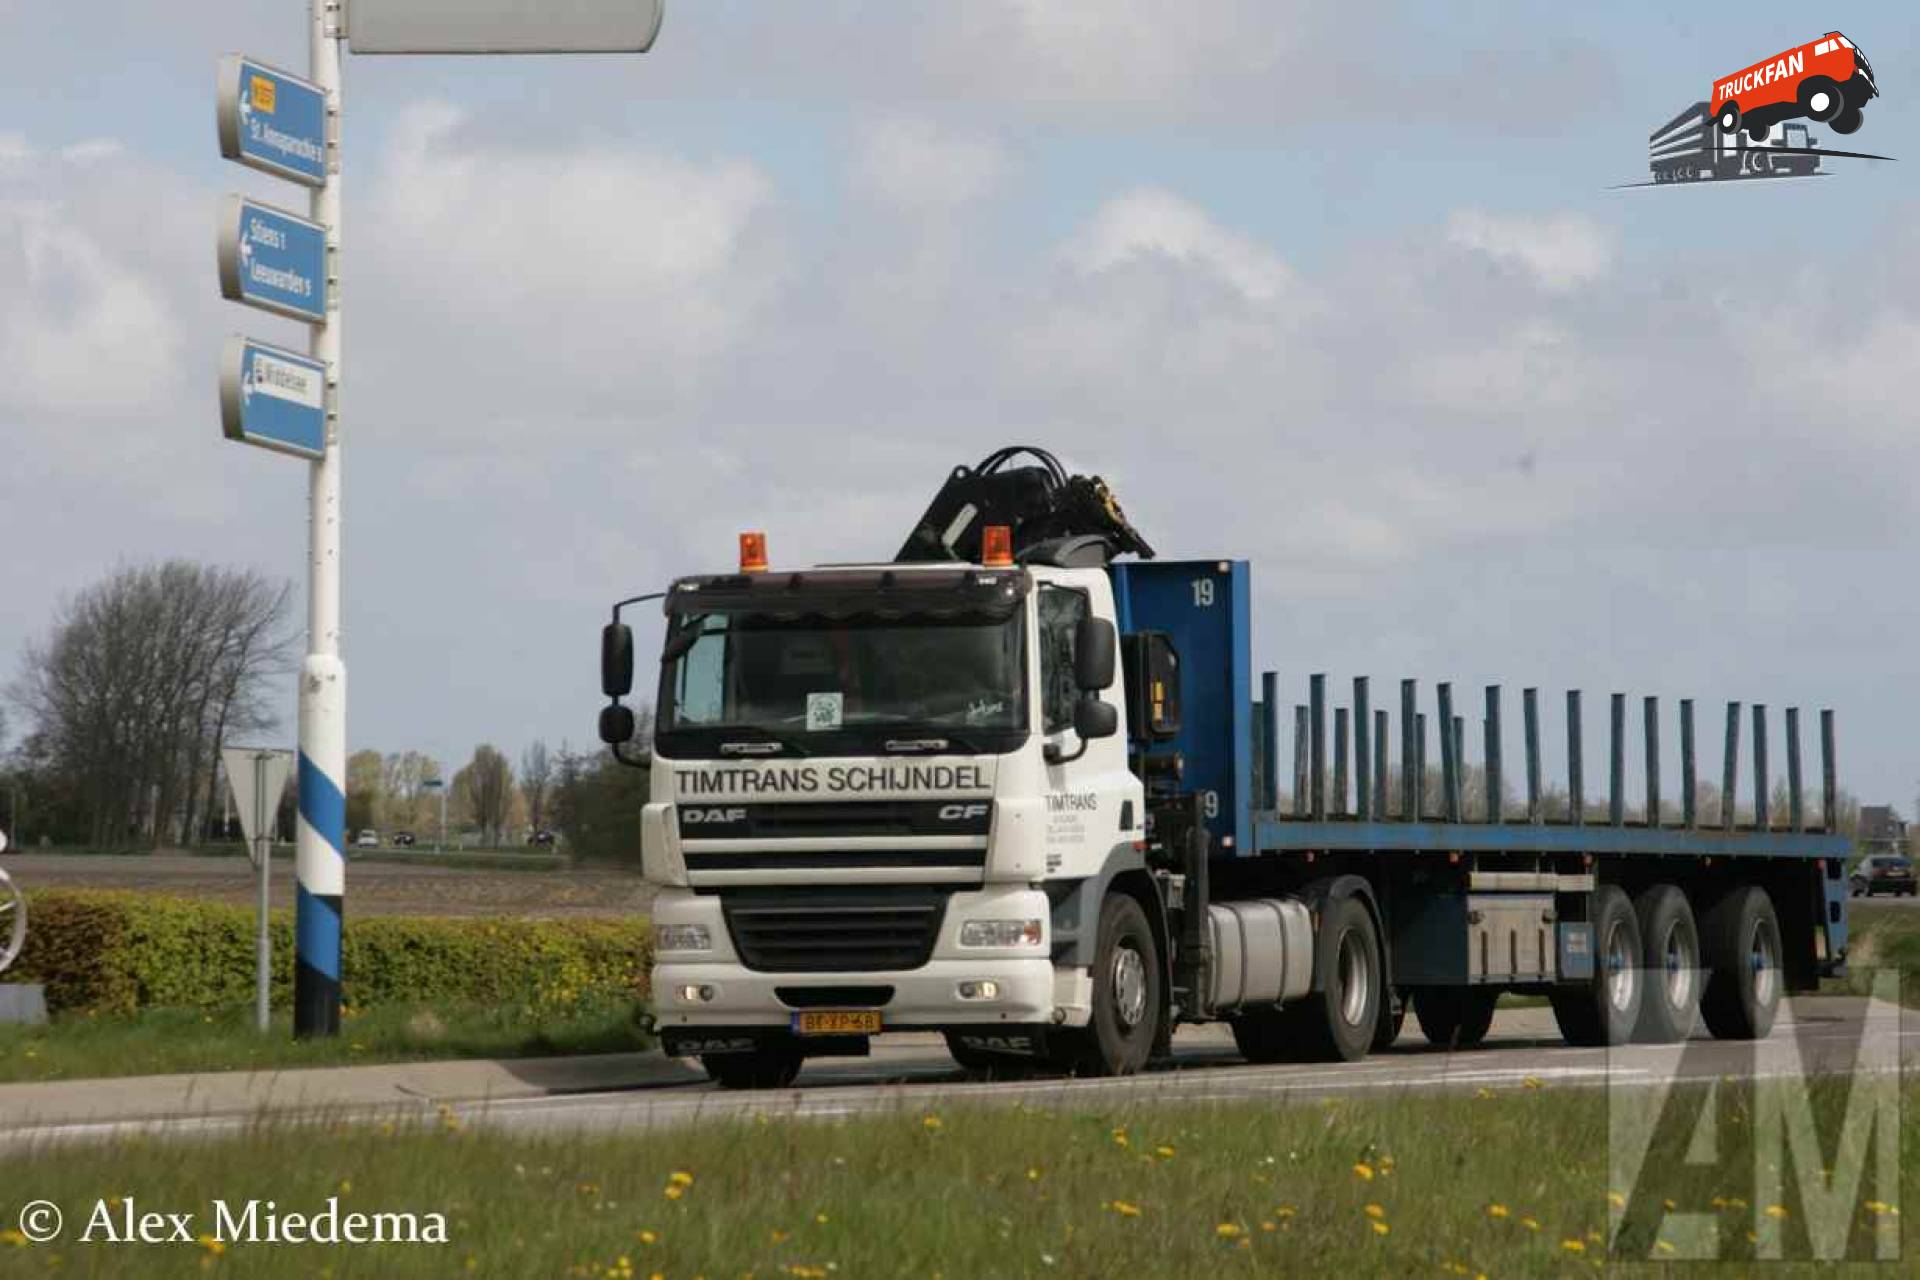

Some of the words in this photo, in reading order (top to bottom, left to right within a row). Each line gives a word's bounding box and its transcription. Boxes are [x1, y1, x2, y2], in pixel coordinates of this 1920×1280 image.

[1190, 578, 1214, 607] 19
[675, 767, 820, 793] TIMTRANS
[827, 765, 991, 792] SCHIJNDEL
[681, 808, 747, 824] DAF
[938, 804, 988, 820] CF
